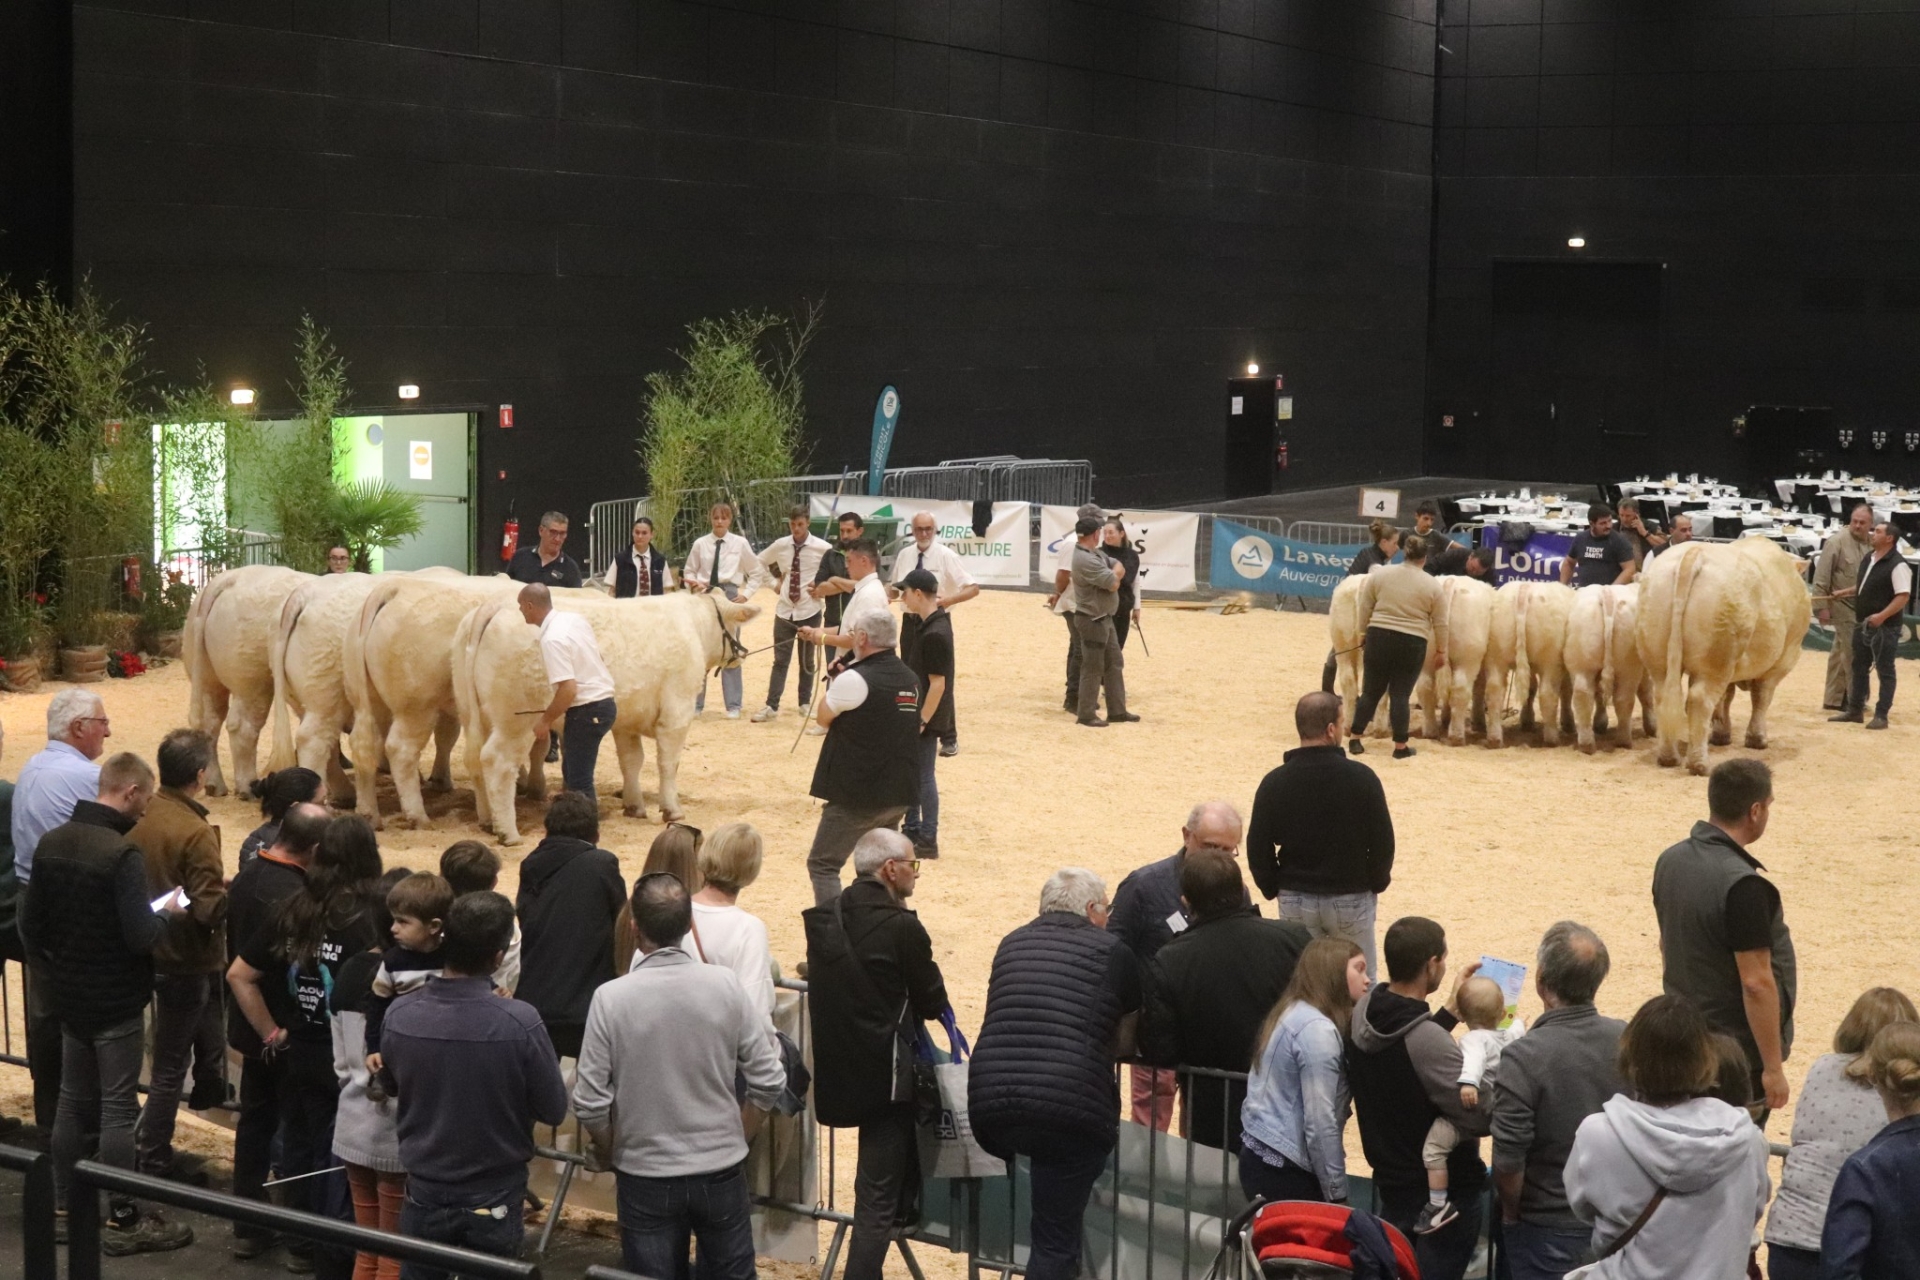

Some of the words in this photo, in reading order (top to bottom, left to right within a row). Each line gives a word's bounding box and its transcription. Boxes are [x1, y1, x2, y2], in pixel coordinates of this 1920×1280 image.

[1375, 501, 1385, 512] 4
[1283, 545, 1309, 564] La
[1312, 553, 1356, 571] Rég
